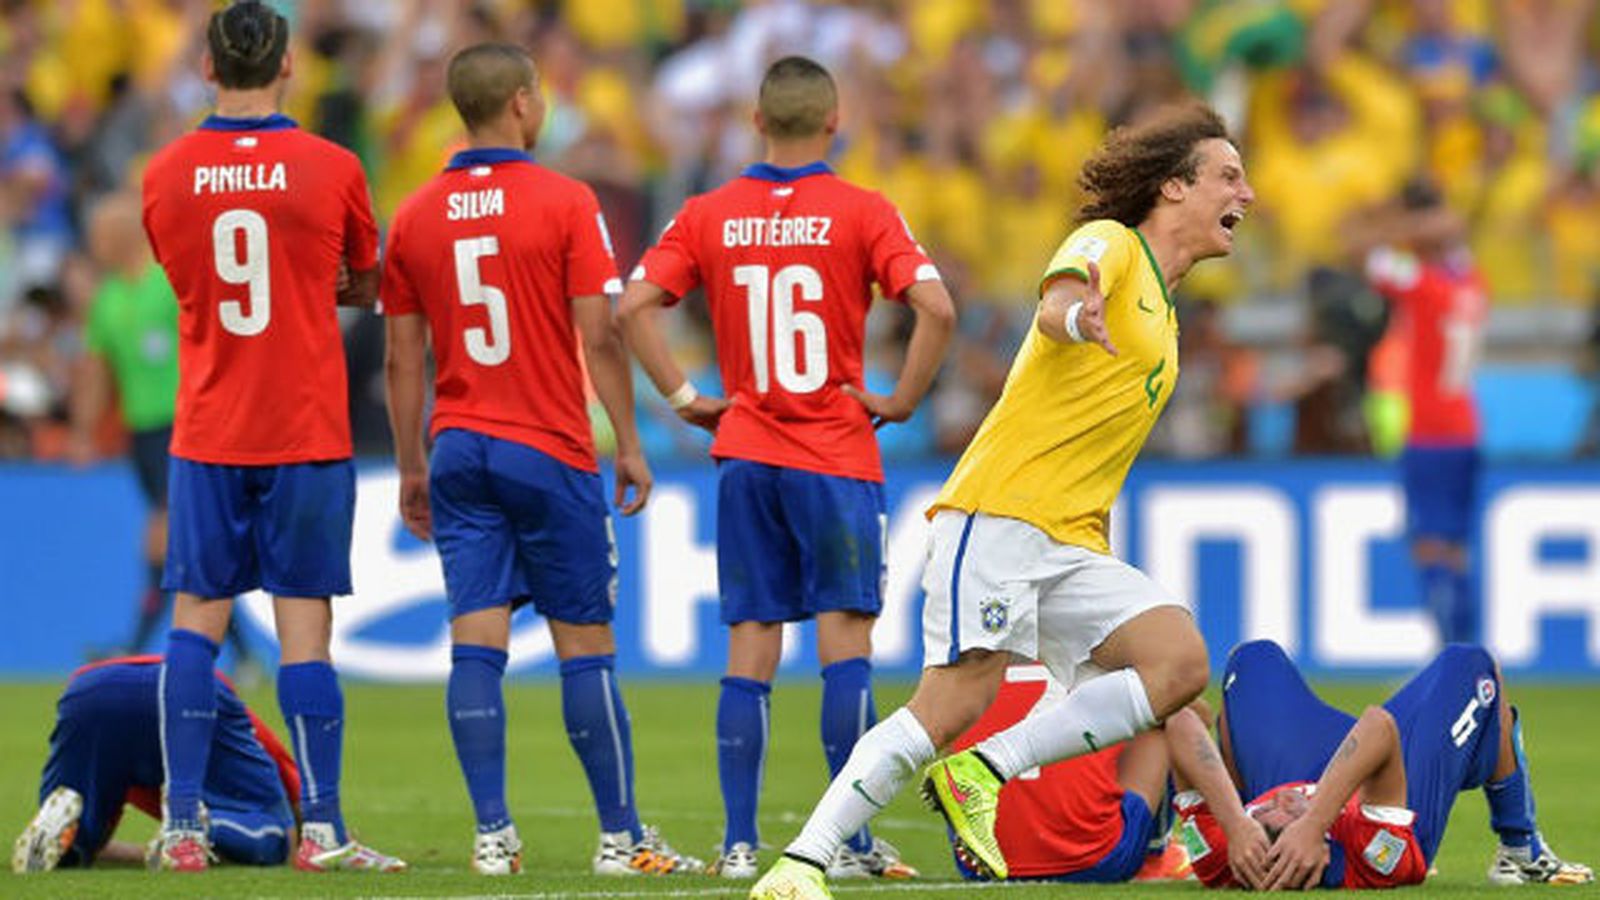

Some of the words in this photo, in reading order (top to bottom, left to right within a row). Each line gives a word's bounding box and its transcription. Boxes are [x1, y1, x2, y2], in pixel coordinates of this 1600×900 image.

[194, 164, 287, 194] PINILLA
[447, 188, 505, 220] SILVA
[722, 213, 832, 248] GUTIÉRREZ
[213, 209, 272, 336] 9
[453, 236, 511, 366] 5
[732, 264, 828, 394] 16
